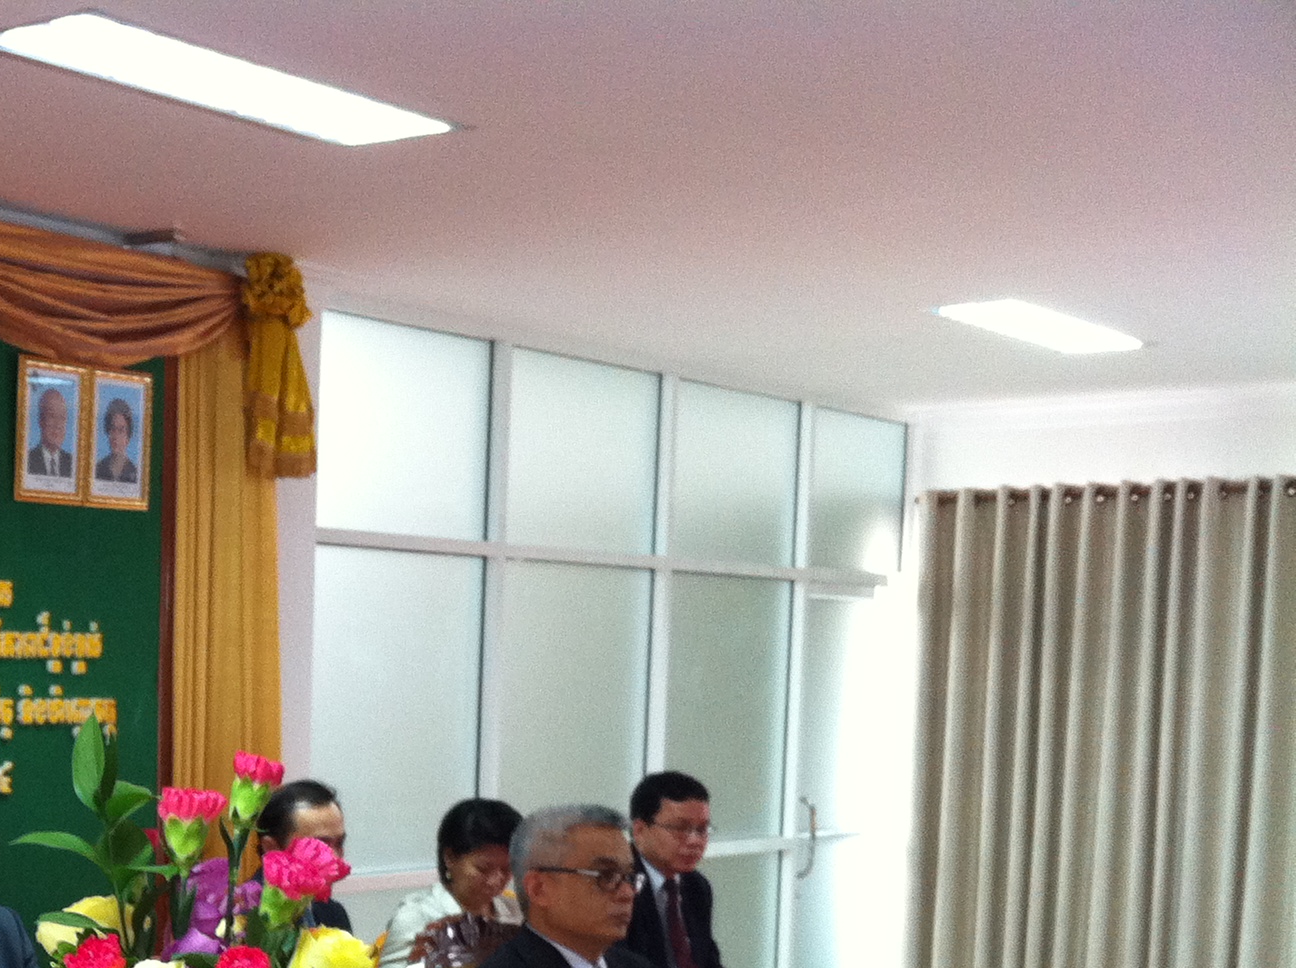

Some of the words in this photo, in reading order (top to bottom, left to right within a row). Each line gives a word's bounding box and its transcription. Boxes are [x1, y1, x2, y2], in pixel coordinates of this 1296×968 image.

[17, 683, 119, 746] និងហិរញ្វត្ថ
